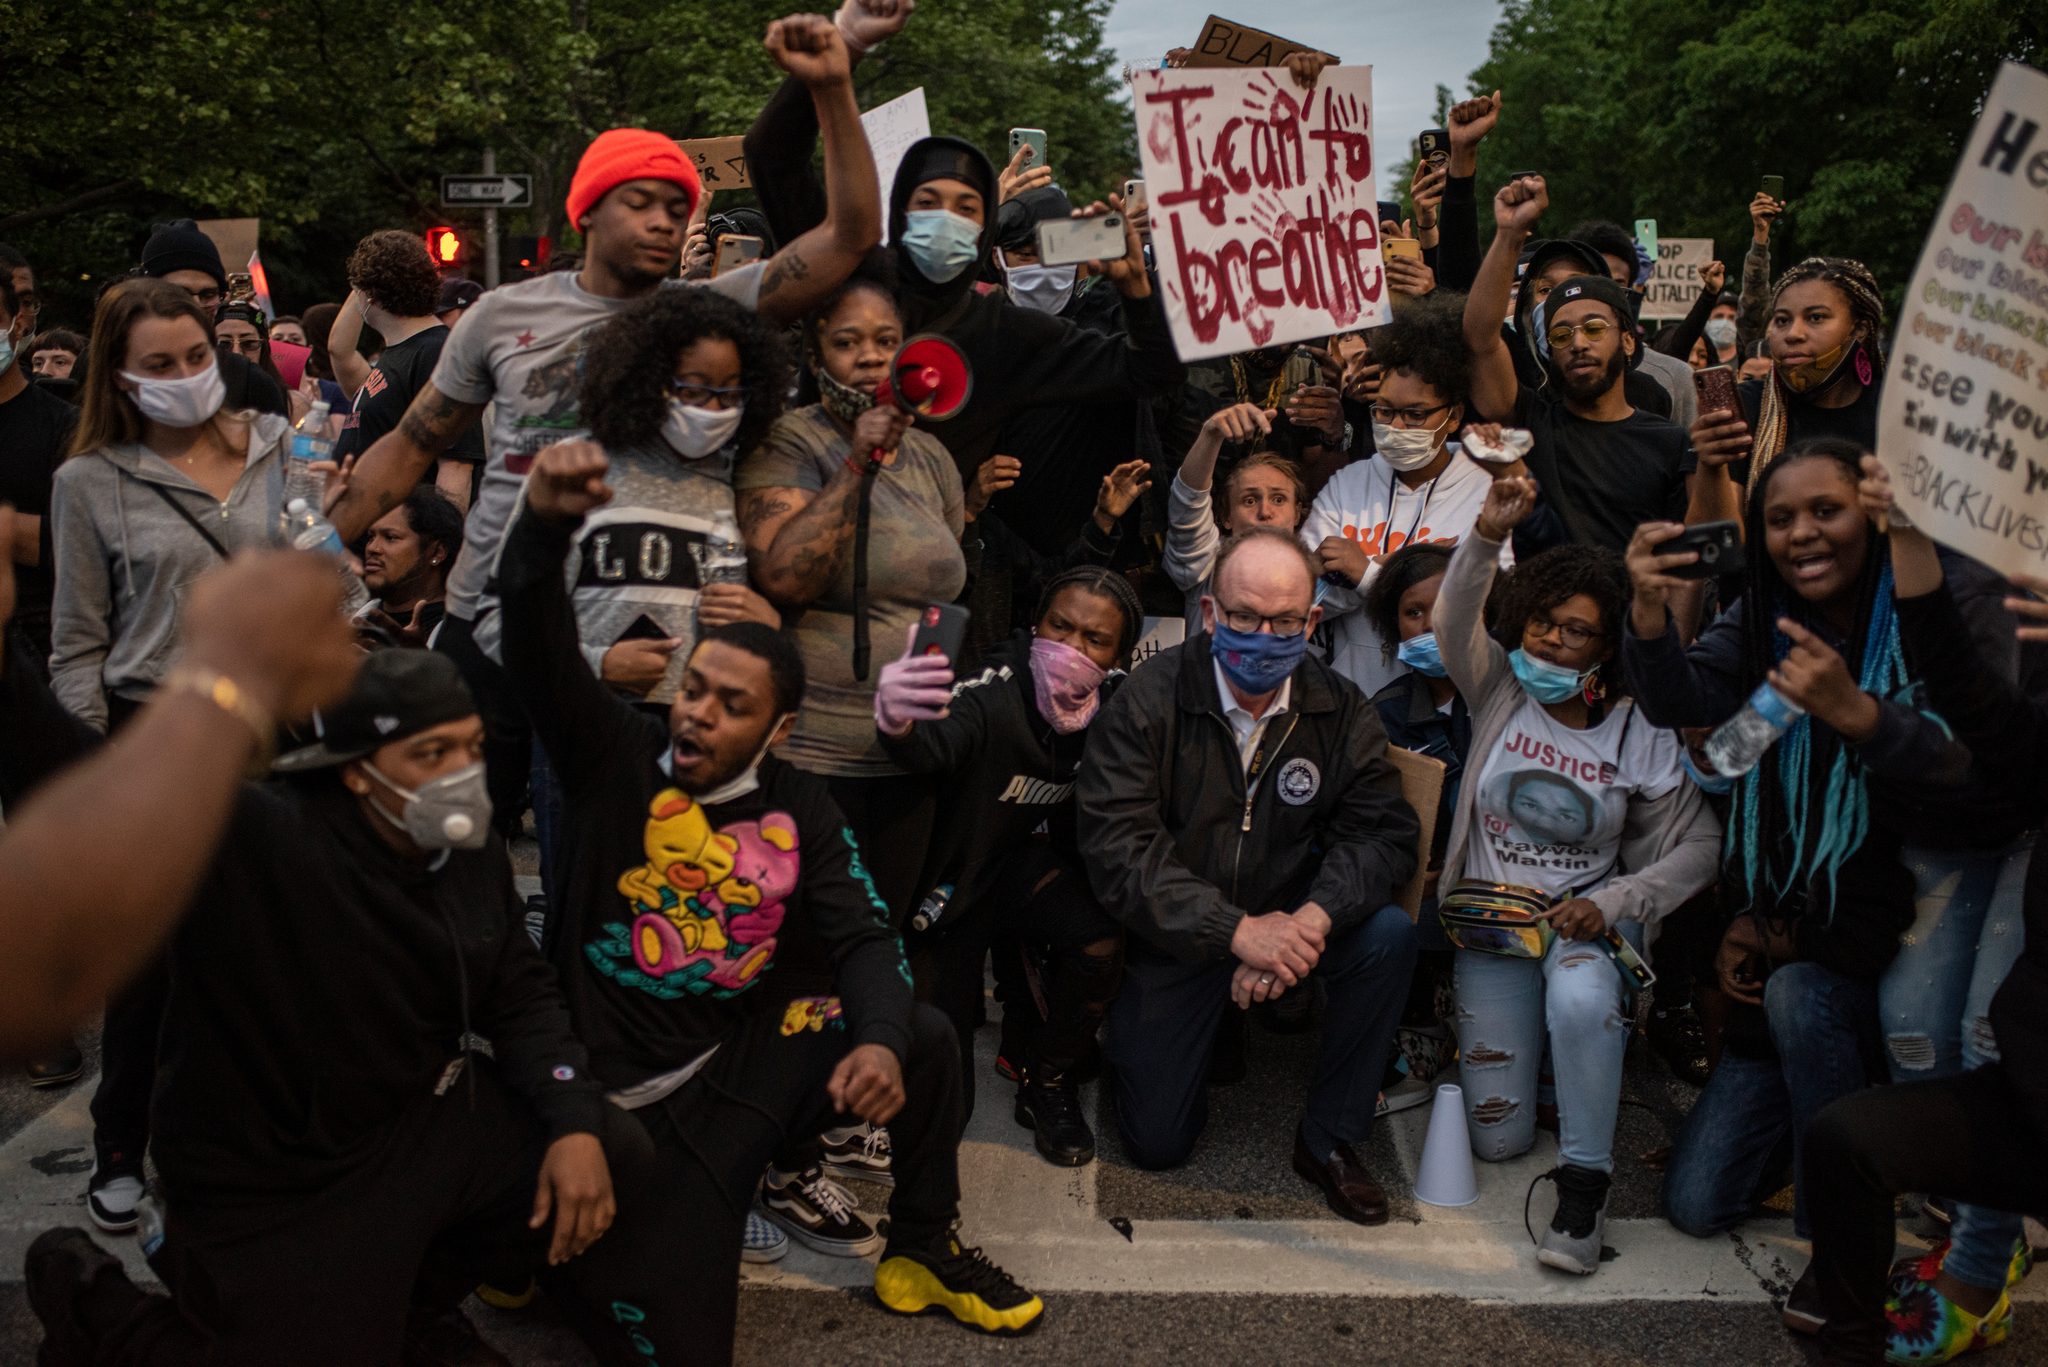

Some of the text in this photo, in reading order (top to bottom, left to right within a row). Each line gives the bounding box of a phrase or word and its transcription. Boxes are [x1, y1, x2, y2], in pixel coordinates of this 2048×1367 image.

[1146, 86, 1229, 206] I
[1169, 188, 1384, 344] breathe
[1658, 243, 1683, 260] OP
[1645, 283, 1704, 303] UTALIT
[1505, 732, 1614, 785] JUSTICE
[1496, 850, 1590, 870] Martin
